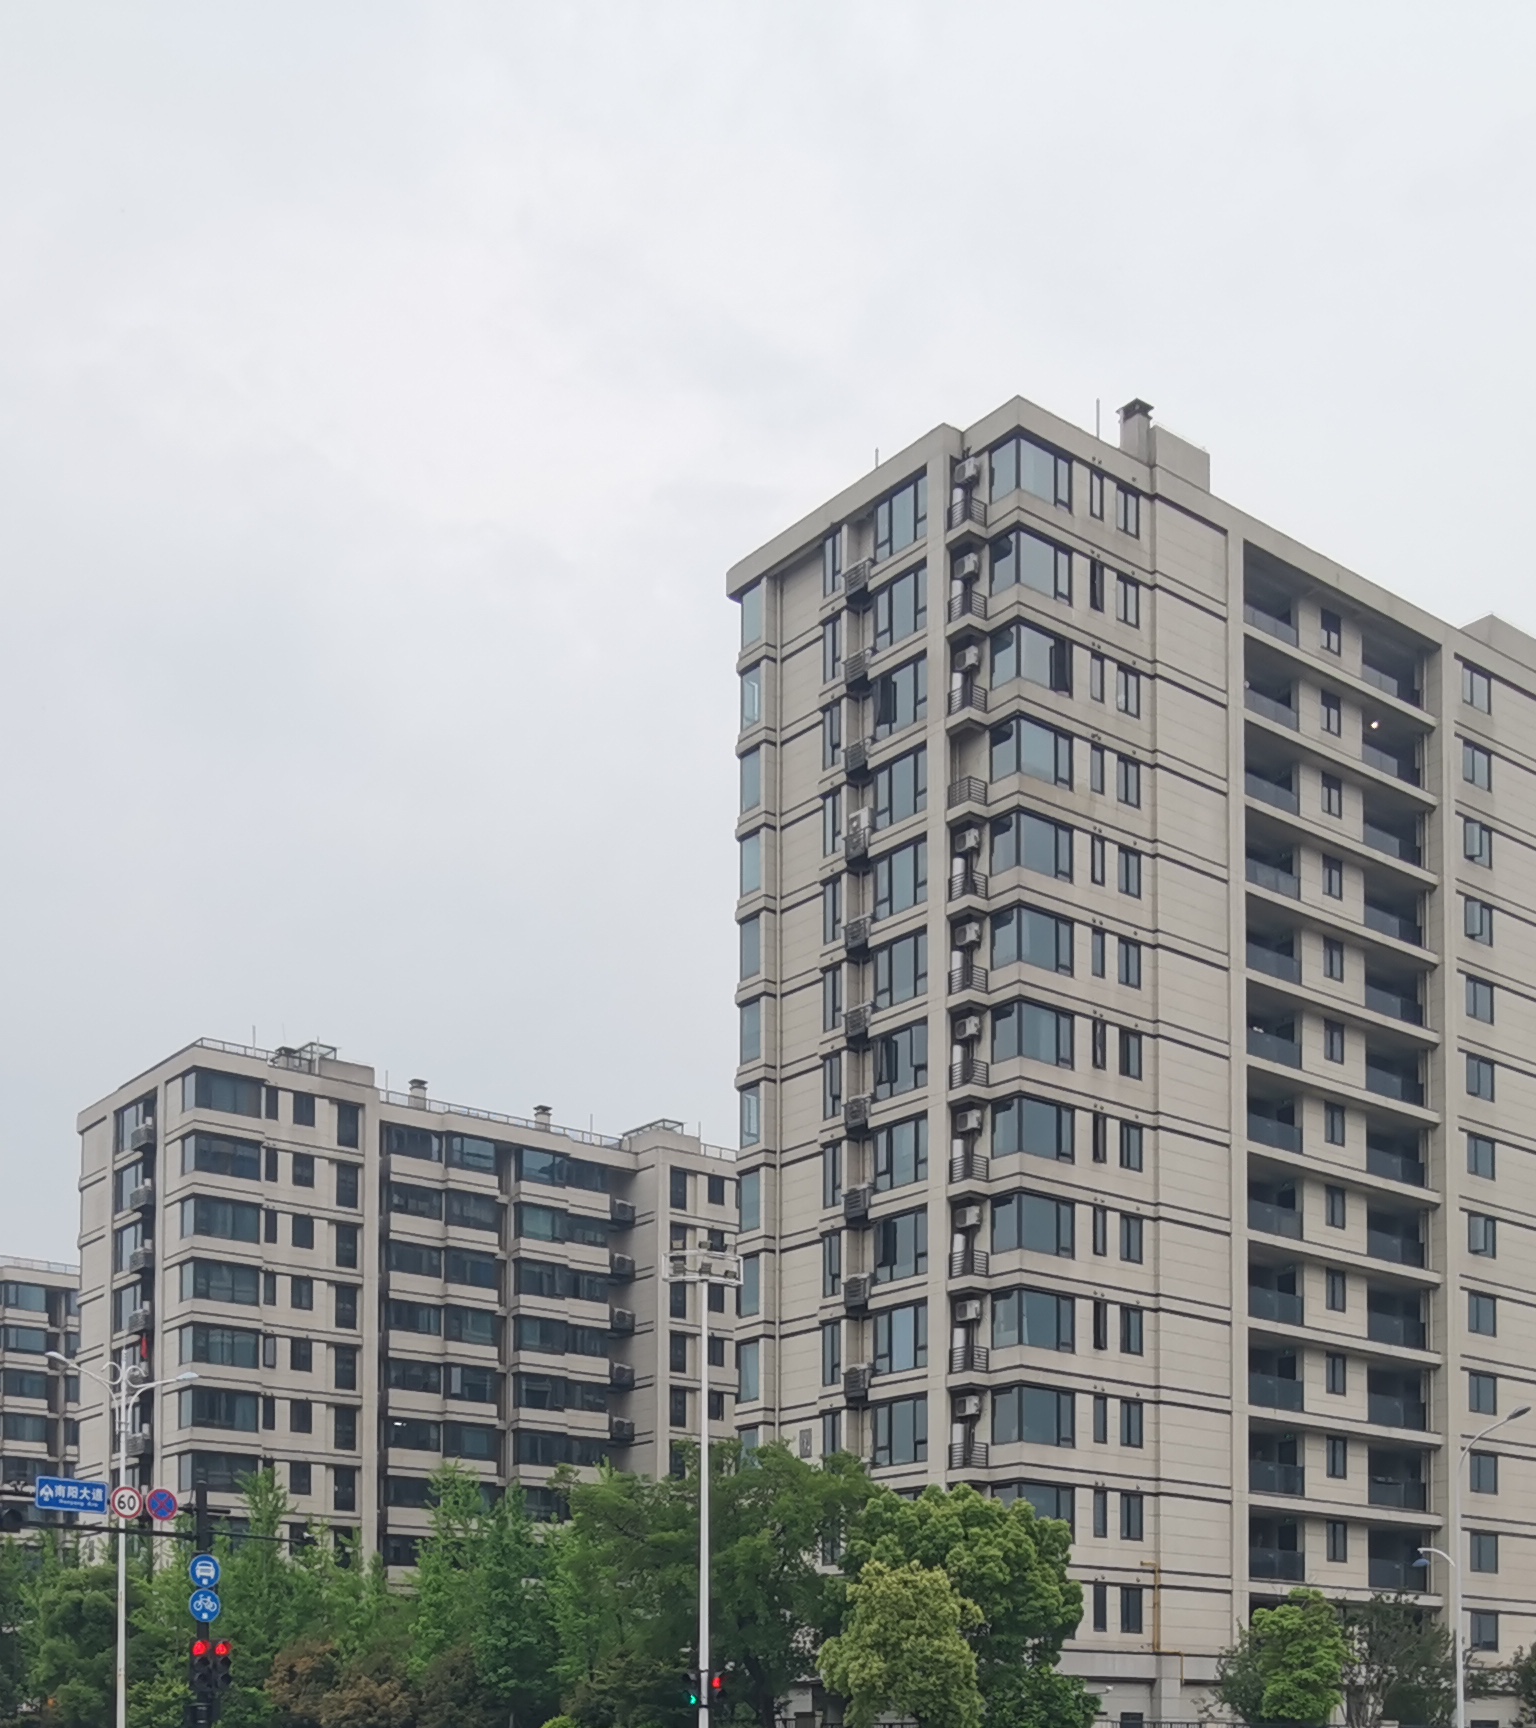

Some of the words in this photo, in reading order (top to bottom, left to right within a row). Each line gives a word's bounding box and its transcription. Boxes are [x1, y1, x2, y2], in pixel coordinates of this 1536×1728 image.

[54, 1484, 104, 1502] 南阳大道
[117, 1494, 137, 1511] 60
